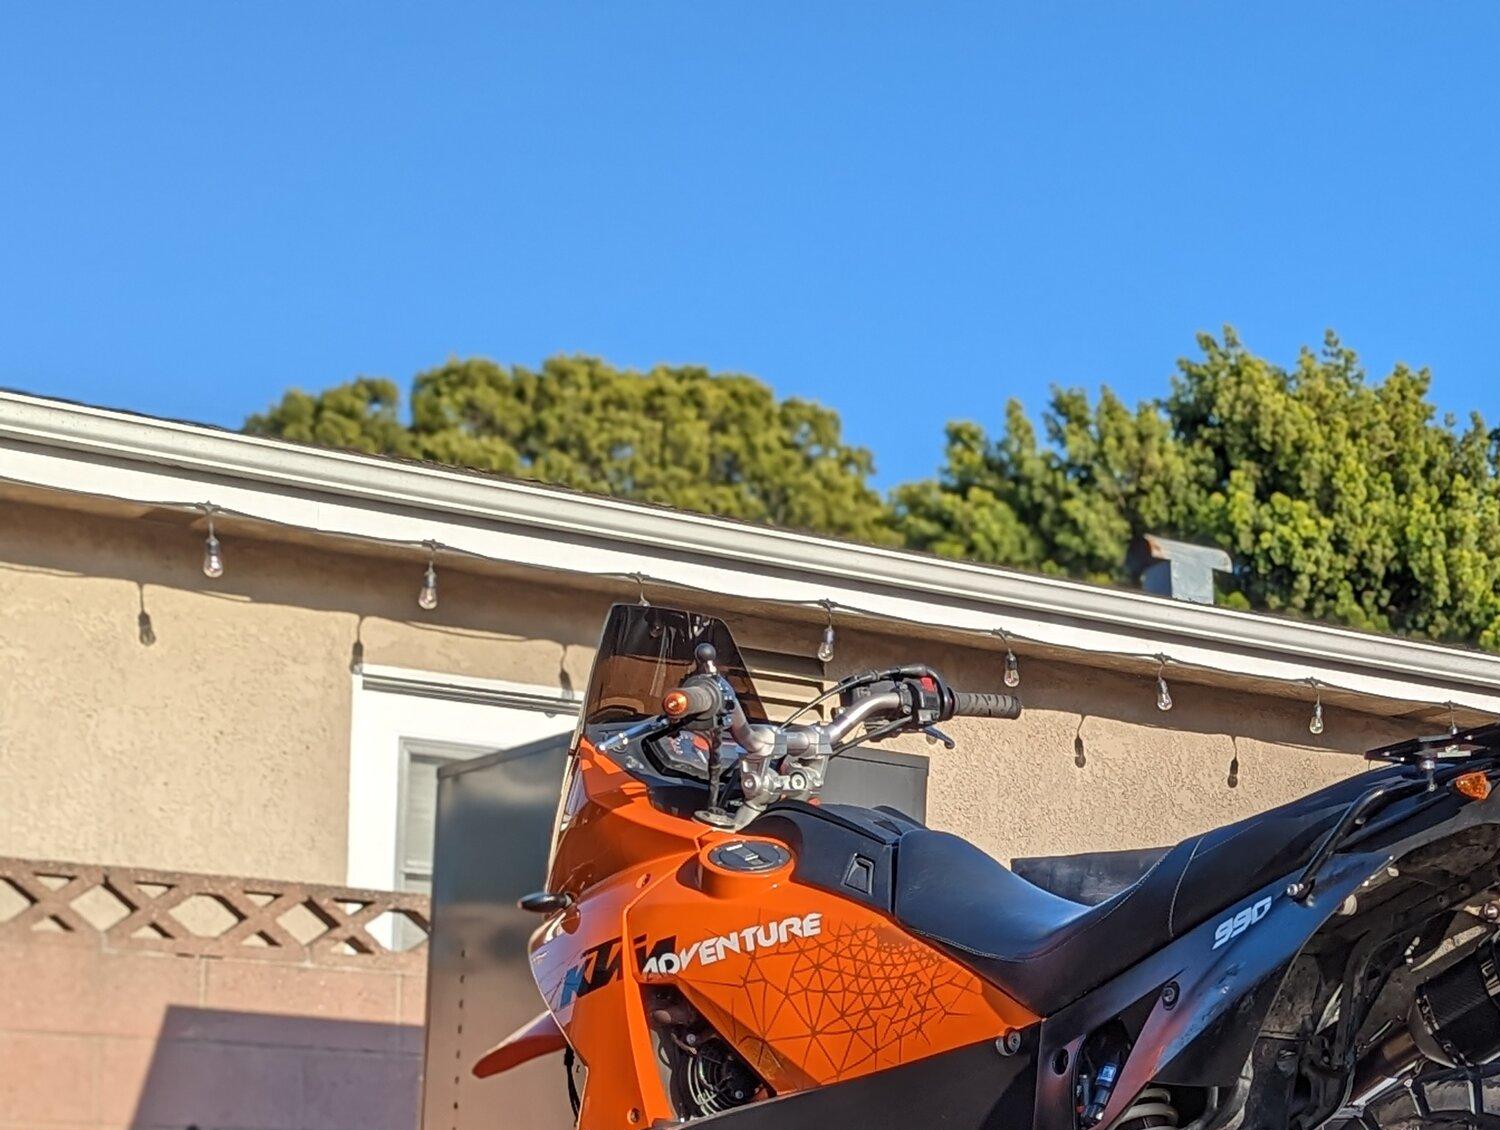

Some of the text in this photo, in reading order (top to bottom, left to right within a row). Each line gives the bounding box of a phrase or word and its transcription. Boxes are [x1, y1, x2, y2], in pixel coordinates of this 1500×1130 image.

[642, 912, 822, 977] ADVENTURE
[1212, 896, 1272, 950] 990
[558, 933, 677, 1008] KTM
